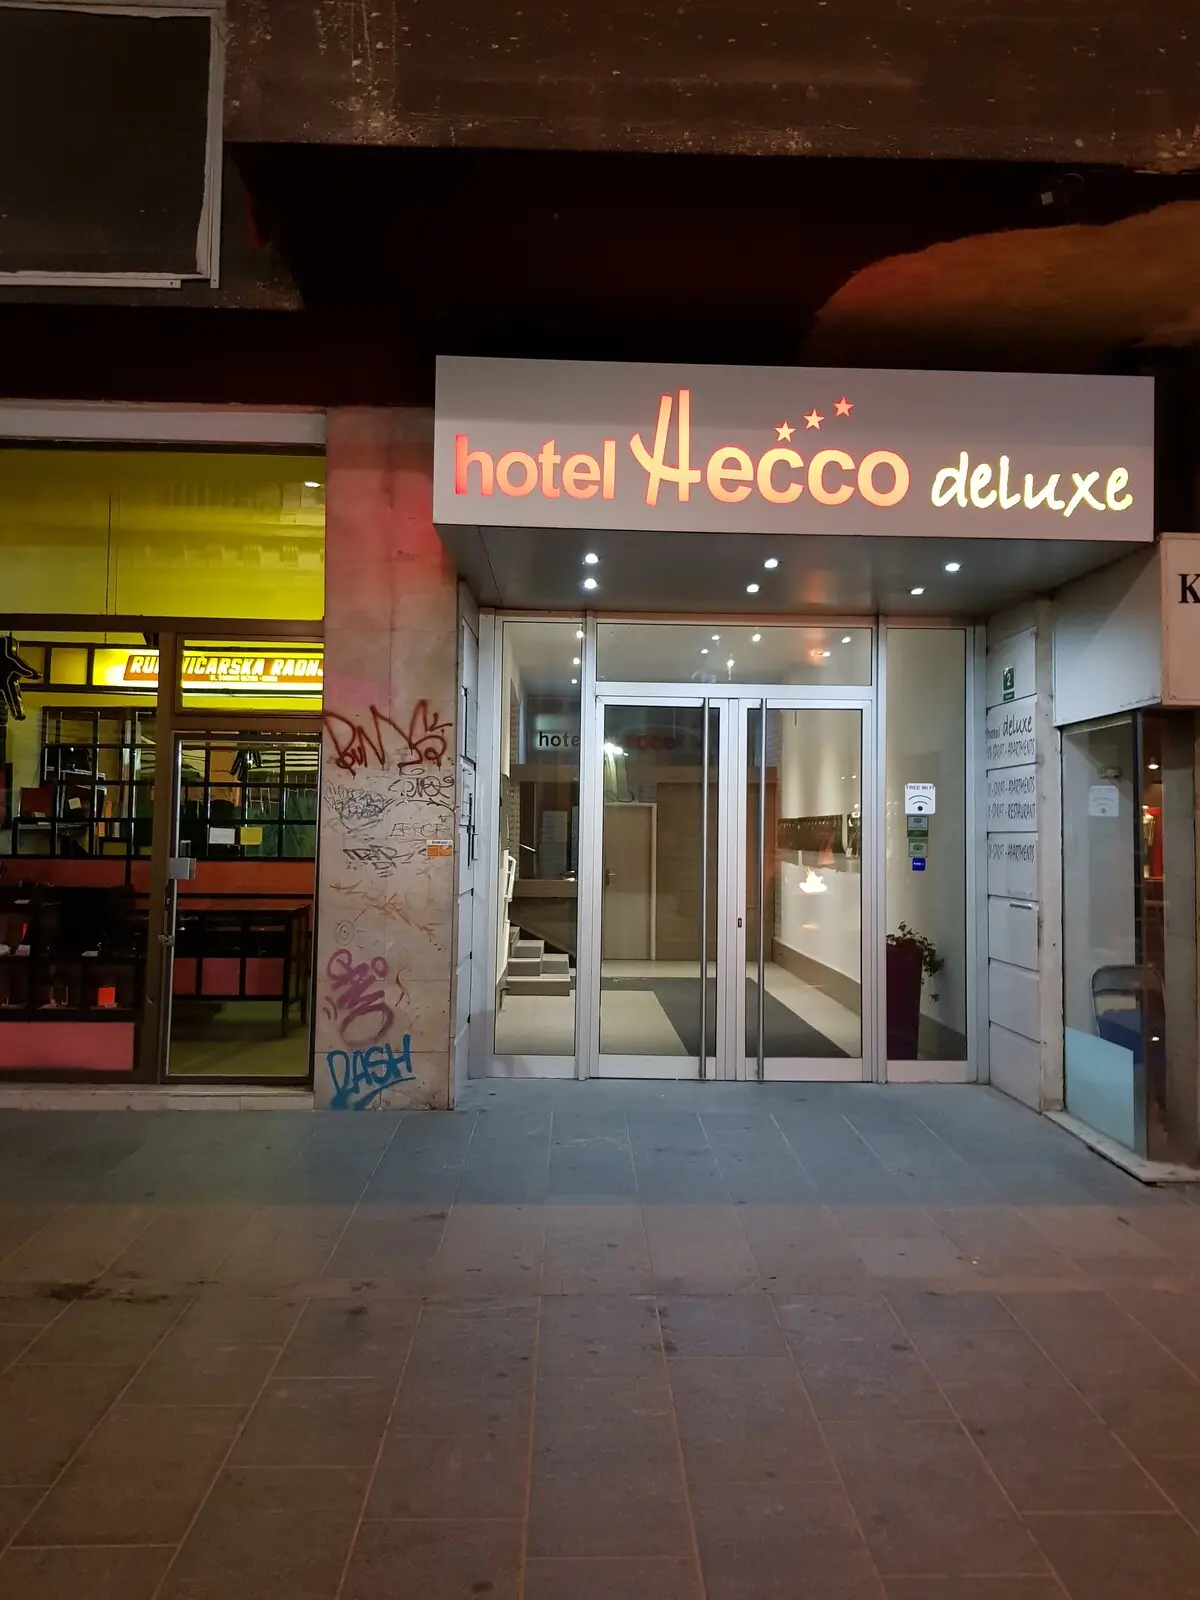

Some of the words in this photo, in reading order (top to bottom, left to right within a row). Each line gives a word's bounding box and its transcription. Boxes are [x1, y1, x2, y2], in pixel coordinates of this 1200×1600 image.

[454, 434, 616, 500] hotel
[629, 388, 910, 506] Hecco
[931, 451, 1133, 517] deluxe
[539, 731, 581, 747] hote
[1003, 714, 1032, 736] deluxe
[327, 1035, 413, 1098] DASH
